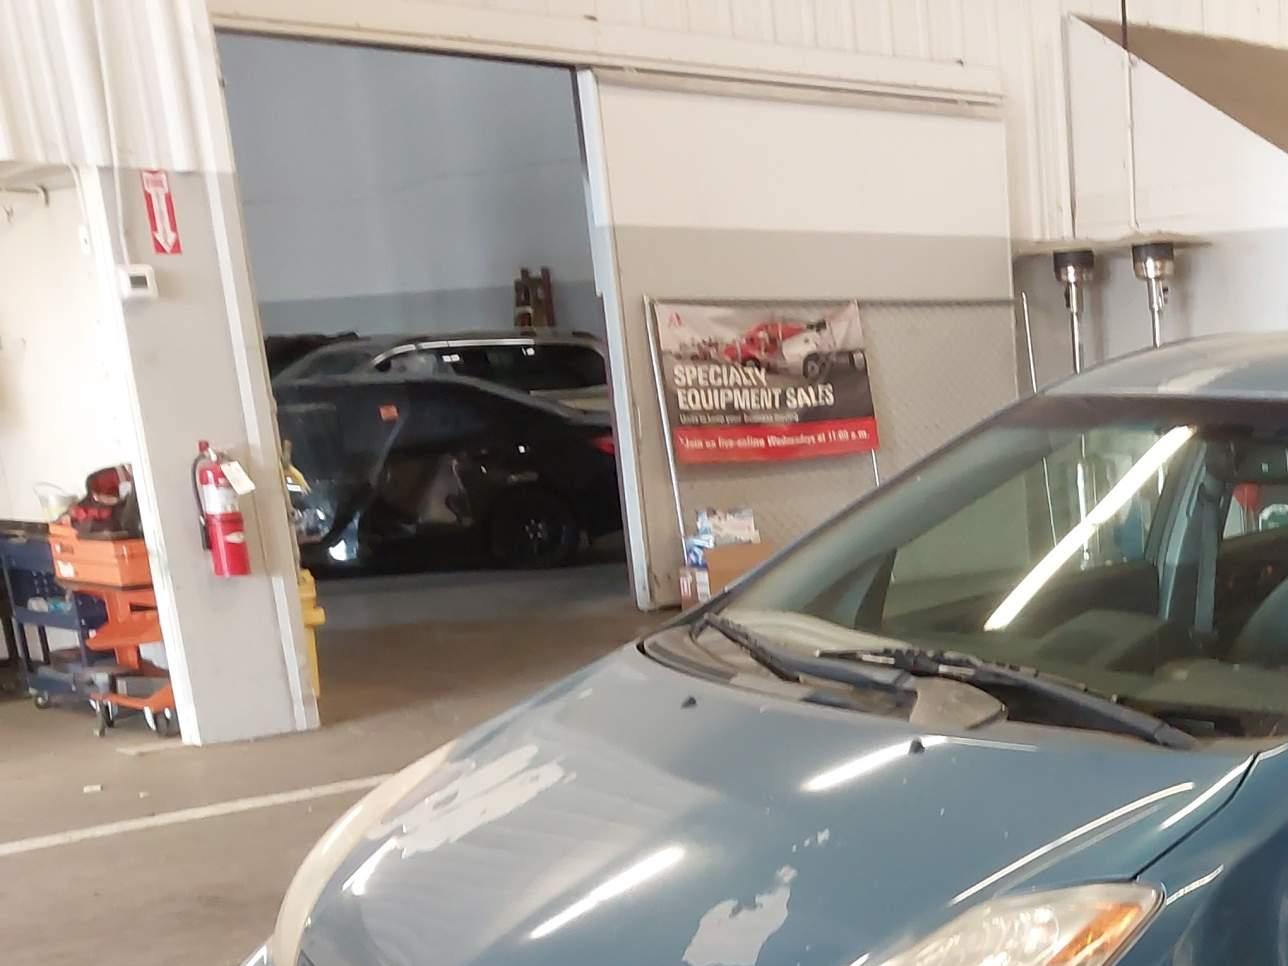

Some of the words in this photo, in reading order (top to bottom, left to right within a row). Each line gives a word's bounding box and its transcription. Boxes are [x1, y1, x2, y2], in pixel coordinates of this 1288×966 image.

[673, 364, 767, 387] SPECIALTY
[677, 388, 782, 410] EQUIPMENT
[785, 383, 835, 409] SALES
